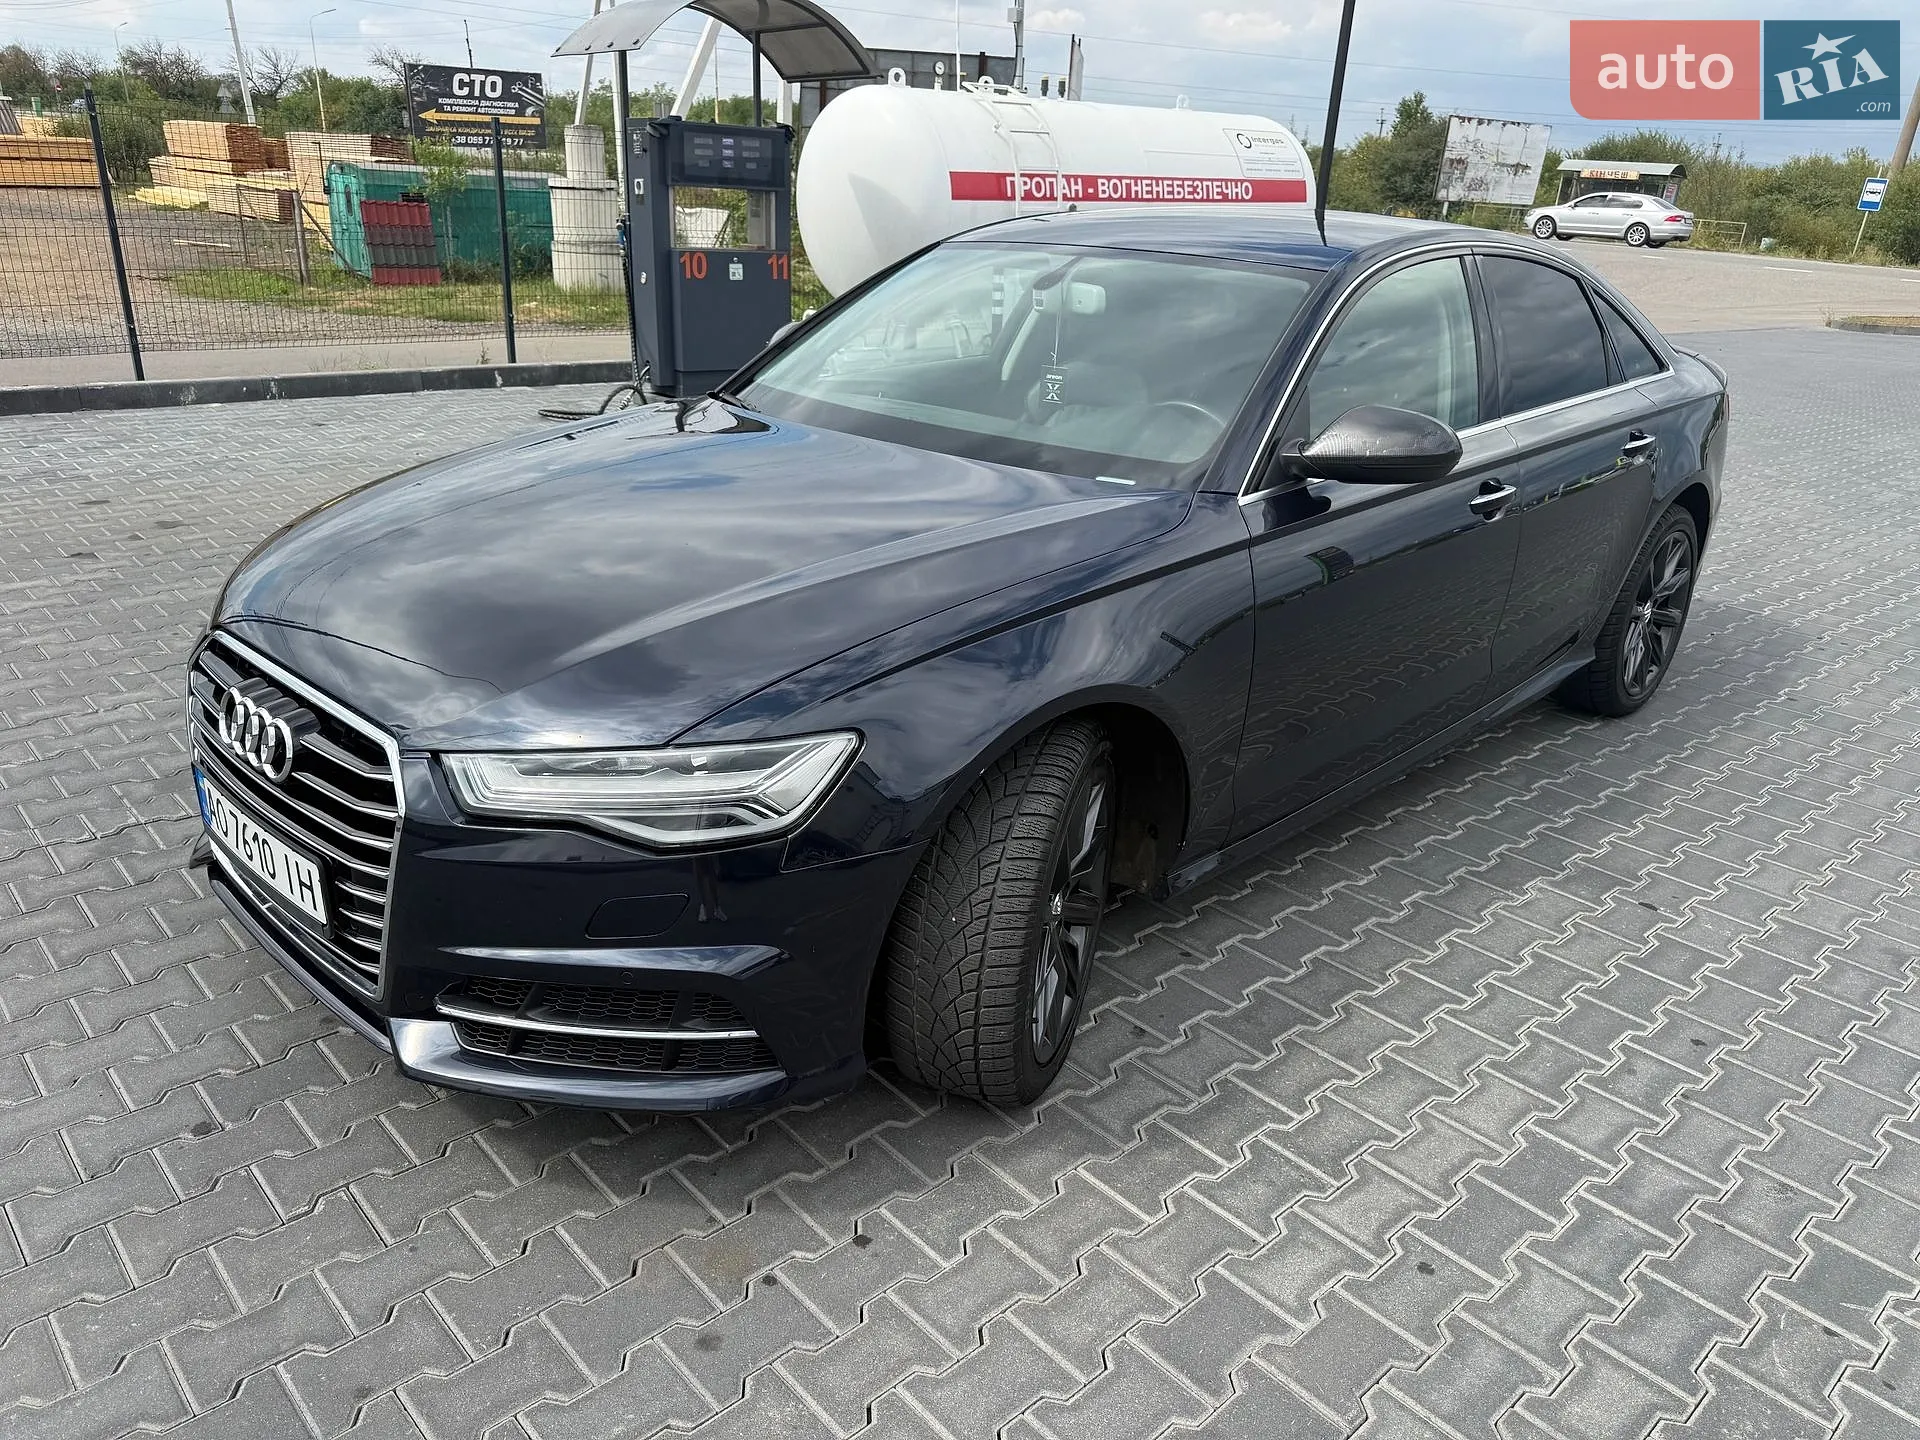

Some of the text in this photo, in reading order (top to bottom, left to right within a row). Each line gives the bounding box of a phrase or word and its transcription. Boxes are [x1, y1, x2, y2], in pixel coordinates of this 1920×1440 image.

[452, 73, 502, 98] СТО
[438, 98, 519, 108] КОМПЛЕКСНА ДІАГНОСТИКА
[1005, 176, 1083, 198] ПРОПАН
[1100, 178, 1252, 200] ВОГНЕНЕБЕЗПЕЧНО
[680, 252, 708, 279] 10
[767, 254, 789, 280] 11
[207, 787, 318, 912] AO 7610 IH
